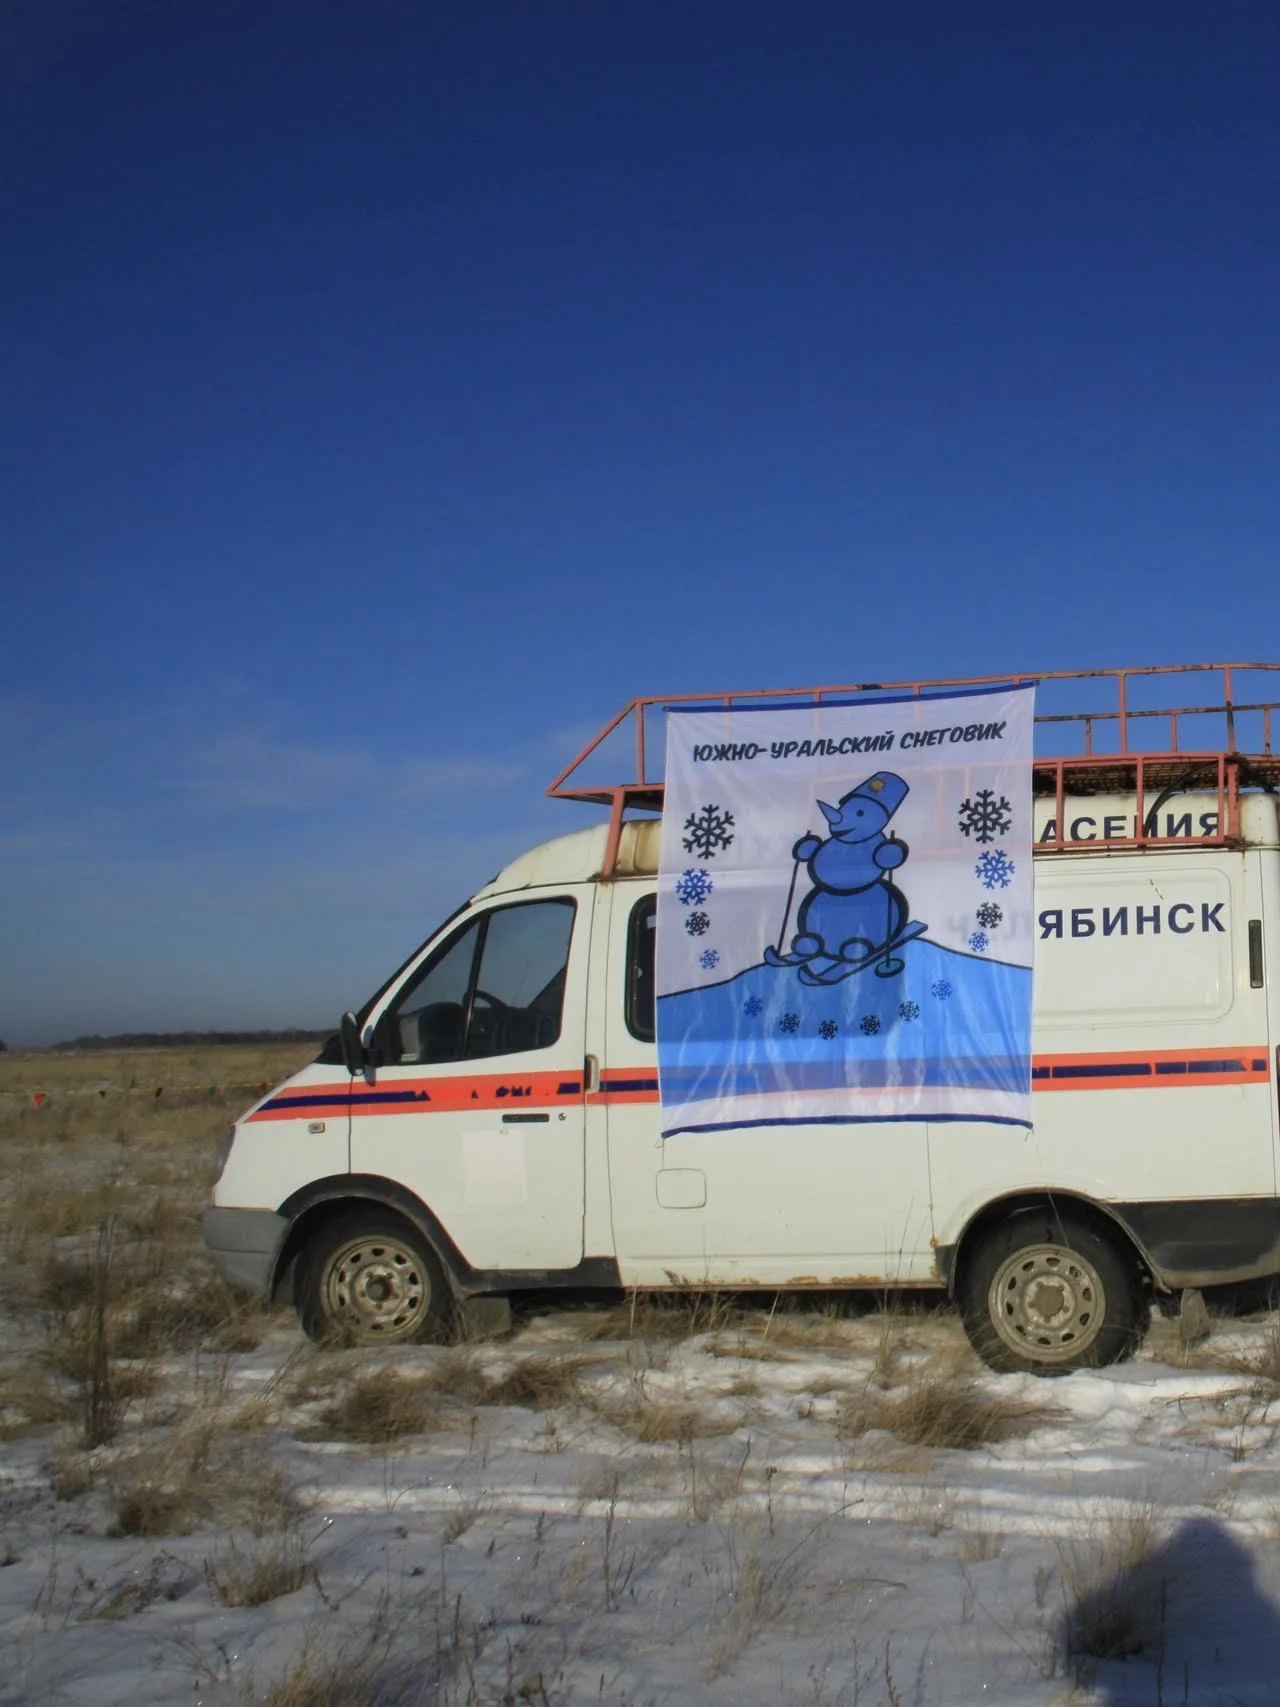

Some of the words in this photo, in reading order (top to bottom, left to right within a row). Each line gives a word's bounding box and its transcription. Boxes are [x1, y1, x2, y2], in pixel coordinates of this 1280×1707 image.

[693, 729, 895, 762] ЮЖНО-УРАЛЬСКИЙ
[900, 720, 1007, 749] СНЕГОВИК
[1038, 902, 1226, 940] ЯБИНСК
